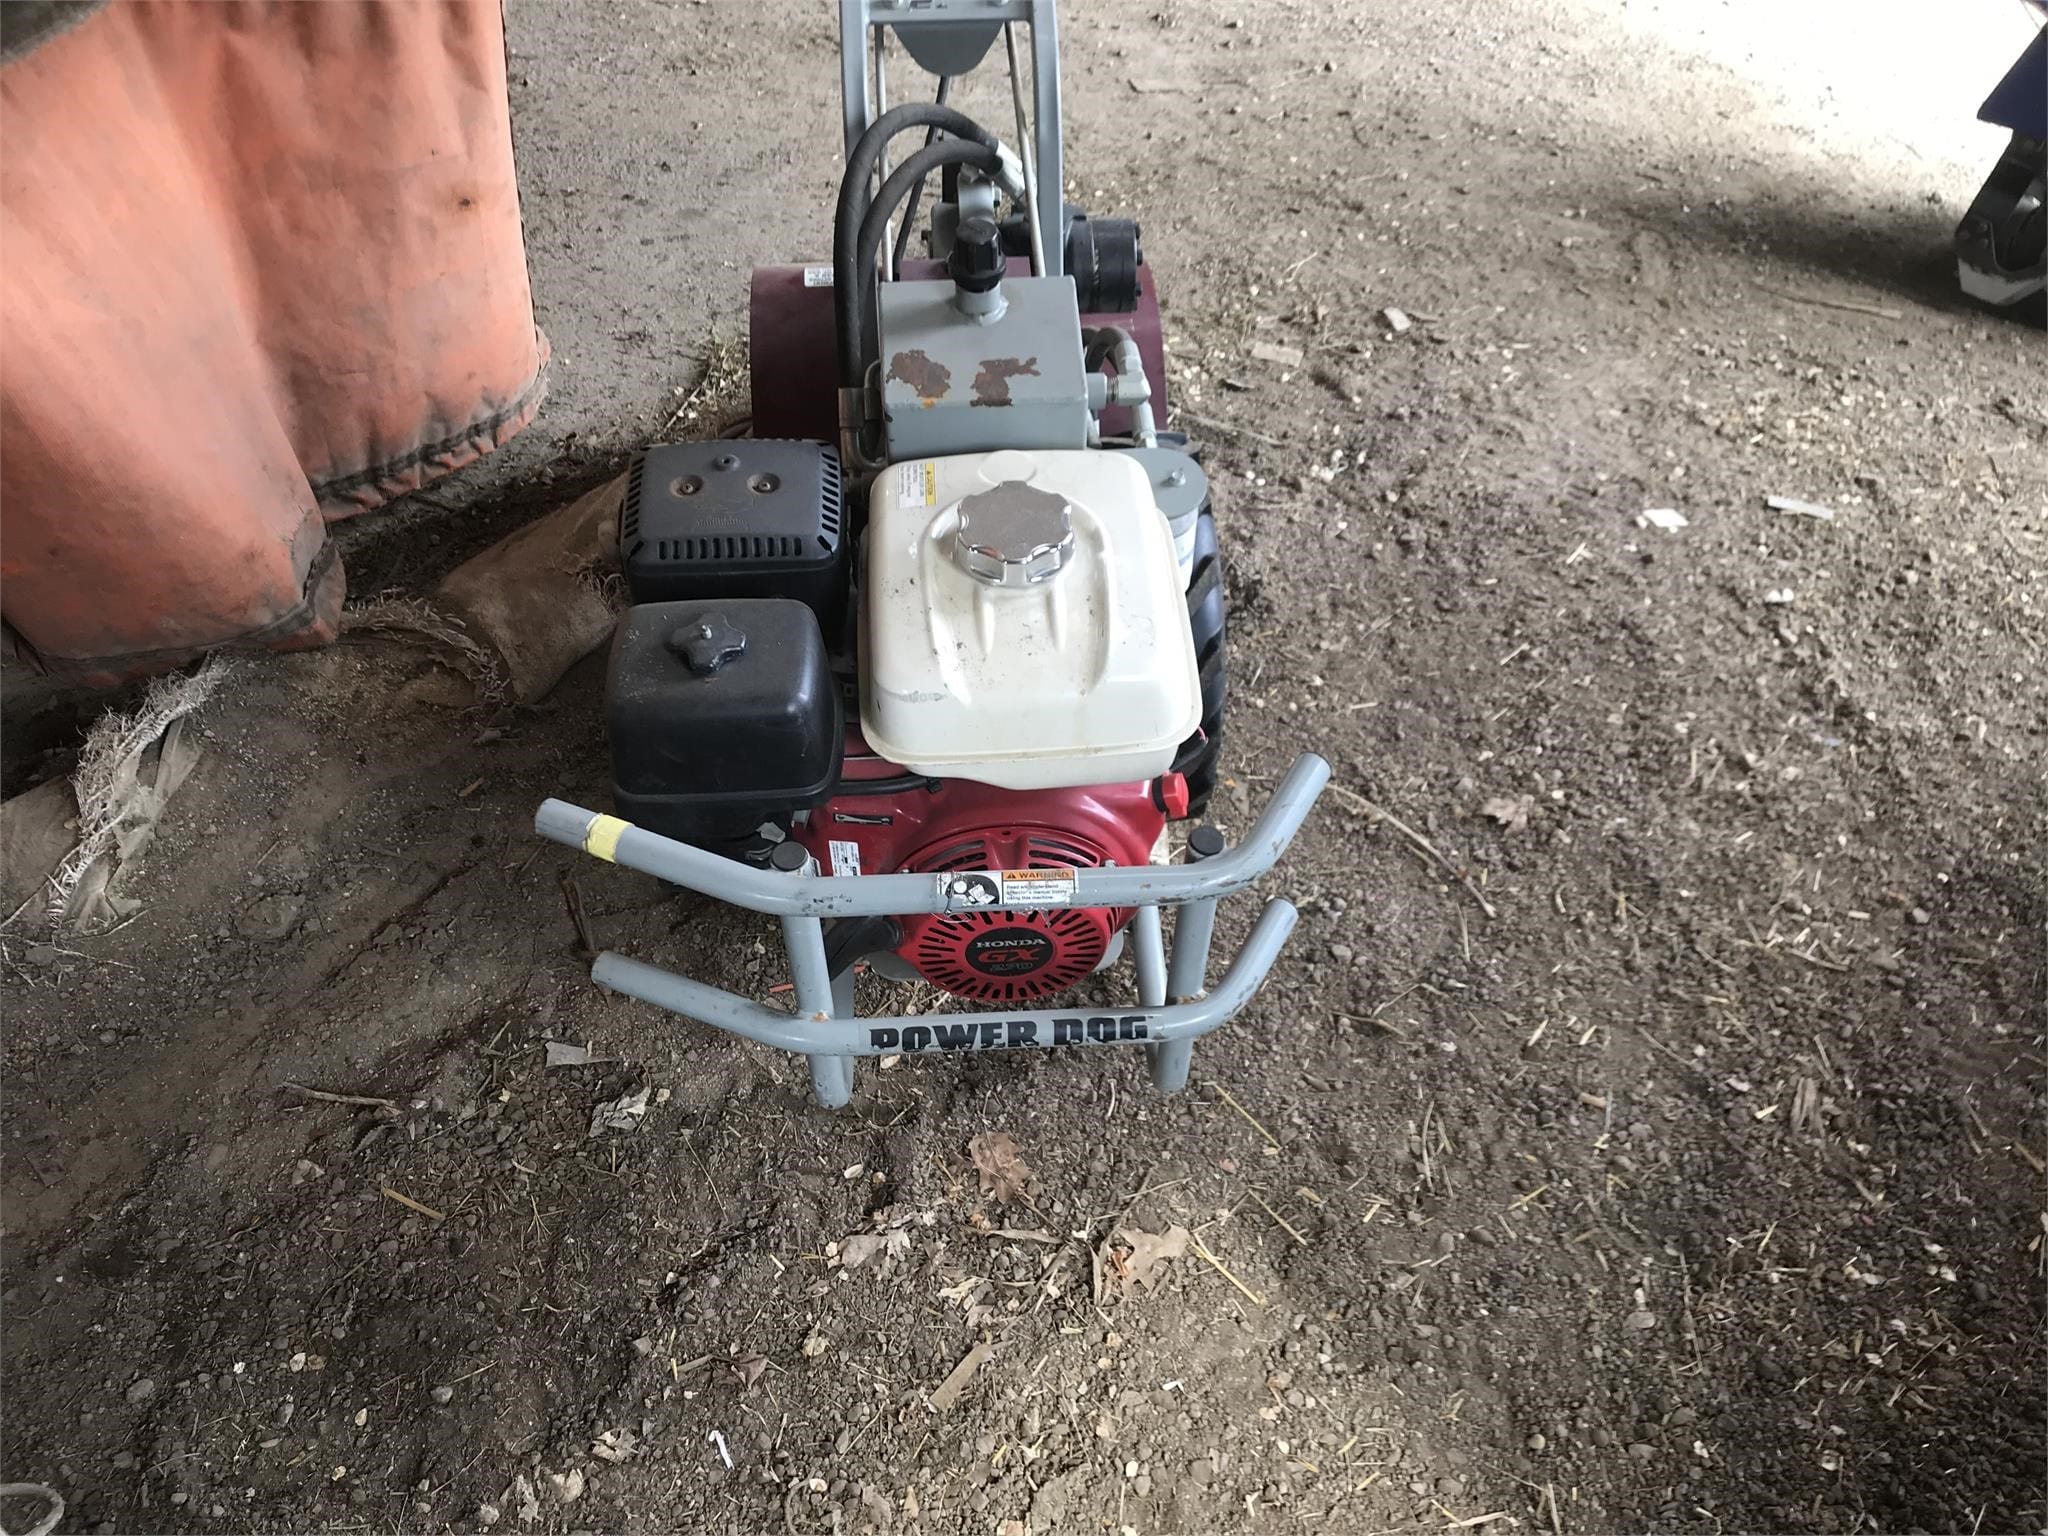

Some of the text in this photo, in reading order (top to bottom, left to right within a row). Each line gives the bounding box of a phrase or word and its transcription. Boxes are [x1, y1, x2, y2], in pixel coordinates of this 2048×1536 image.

[976, 938, 1046, 948] HONDA
[978, 947, 1043, 963] GX
[868, 1016, 1148, 1052] POWER DOG
